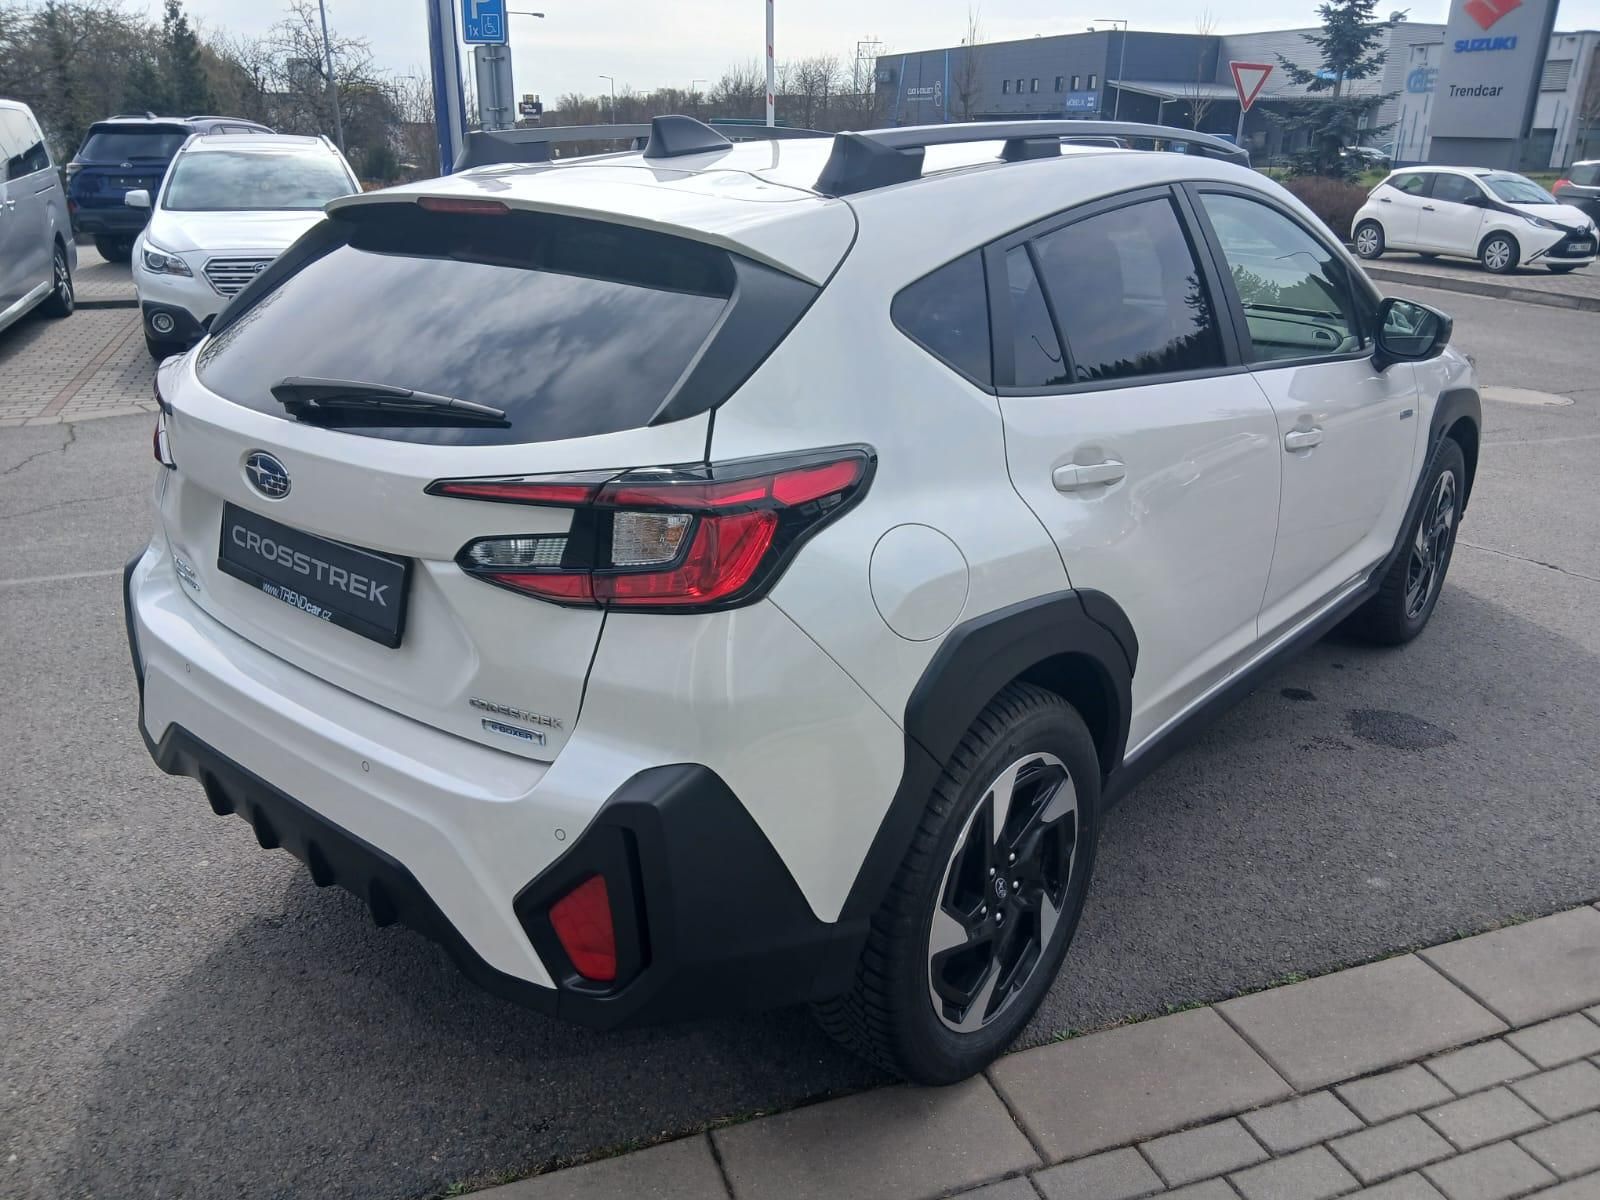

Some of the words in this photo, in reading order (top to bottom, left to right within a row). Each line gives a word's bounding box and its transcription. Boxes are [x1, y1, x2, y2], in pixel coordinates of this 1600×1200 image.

[468, 25, 479, 37] 1x
[1454, 36, 1518, 53] SUZUKI
[1449, 84, 1503, 97] Trendcar
[232, 525, 389, 607] CROSSTREK
